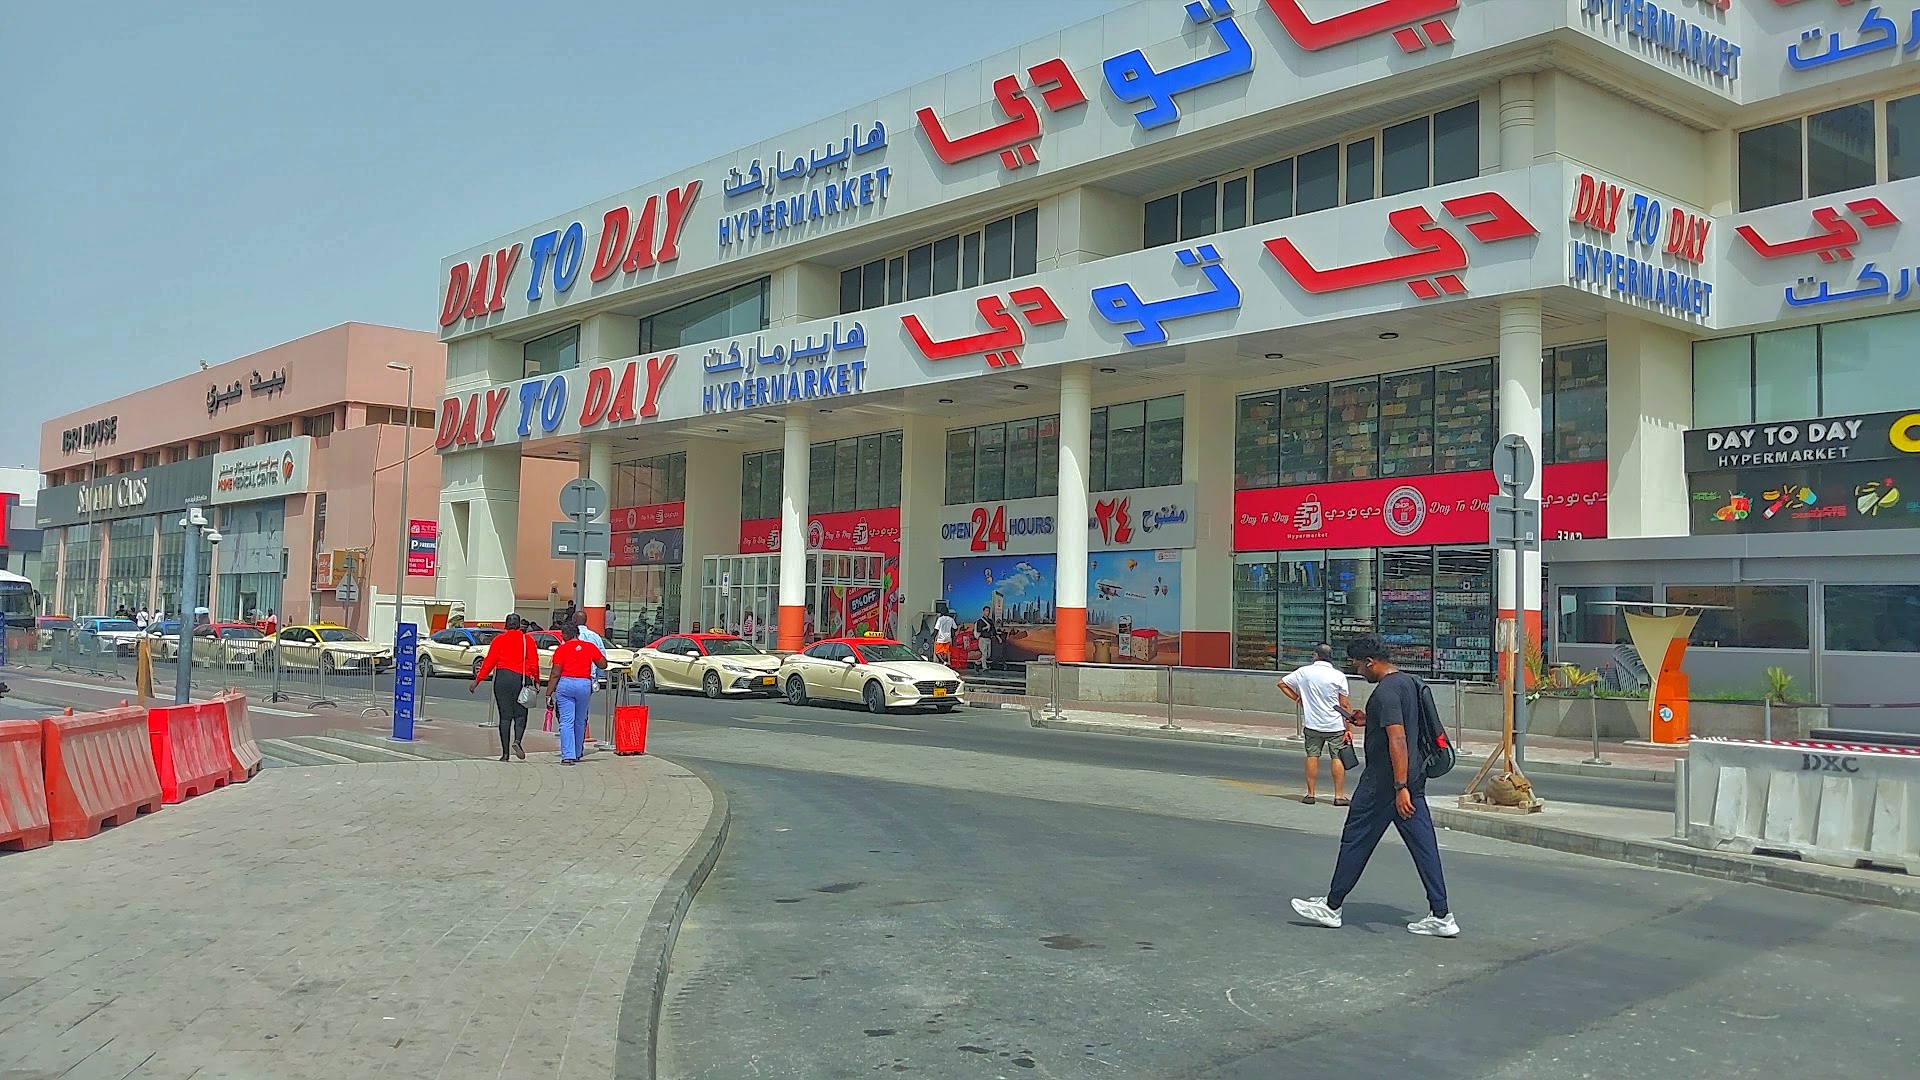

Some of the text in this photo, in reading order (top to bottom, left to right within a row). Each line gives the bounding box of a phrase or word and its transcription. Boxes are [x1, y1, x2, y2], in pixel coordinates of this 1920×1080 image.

[1581, 0, 1741, 81] HYPERMARKET
[915, 57, 1090, 171] دي
[723, 120, 888, 198] هايبرماركت
[719, 167, 892, 246] HYPERMARKET
[1571, 172, 1712, 265] DAY TO DAY
[1734, 197, 1902, 264] دي
[439, 179, 704, 327] DAY TO DAY
[1569, 240, 1713, 319] HYPERMARKET
[900, 192, 1541, 369] دي تو دي
[703, 320, 868, 374] هايبرماركت
[249, 366, 286, 394] بيت
[435, 353, 679, 449] DAY TO DAY
[702, 360, 868, 413] HYPERMARKET
[62, 415, 118, 452] IBRI HOUSE
[1707, 419, 1863, 452] DAY TO DAY
[1718, 446, 1850, 467] HYPERMARKET
[117, 477, 148, 508] CARS
[1142, 504, 1187, 533] مفتوح
[1240, 511, 1289, 526] Day To Day
[1429, 501, 1451, 515] Day
[1455, 500, 1467, 512] To
[941, 505, 1054, 551] OPEN 24 HOURS
[1287, 532, 1329, 540] Hypermarket
[1802, 753, 1860, 773] DXC
